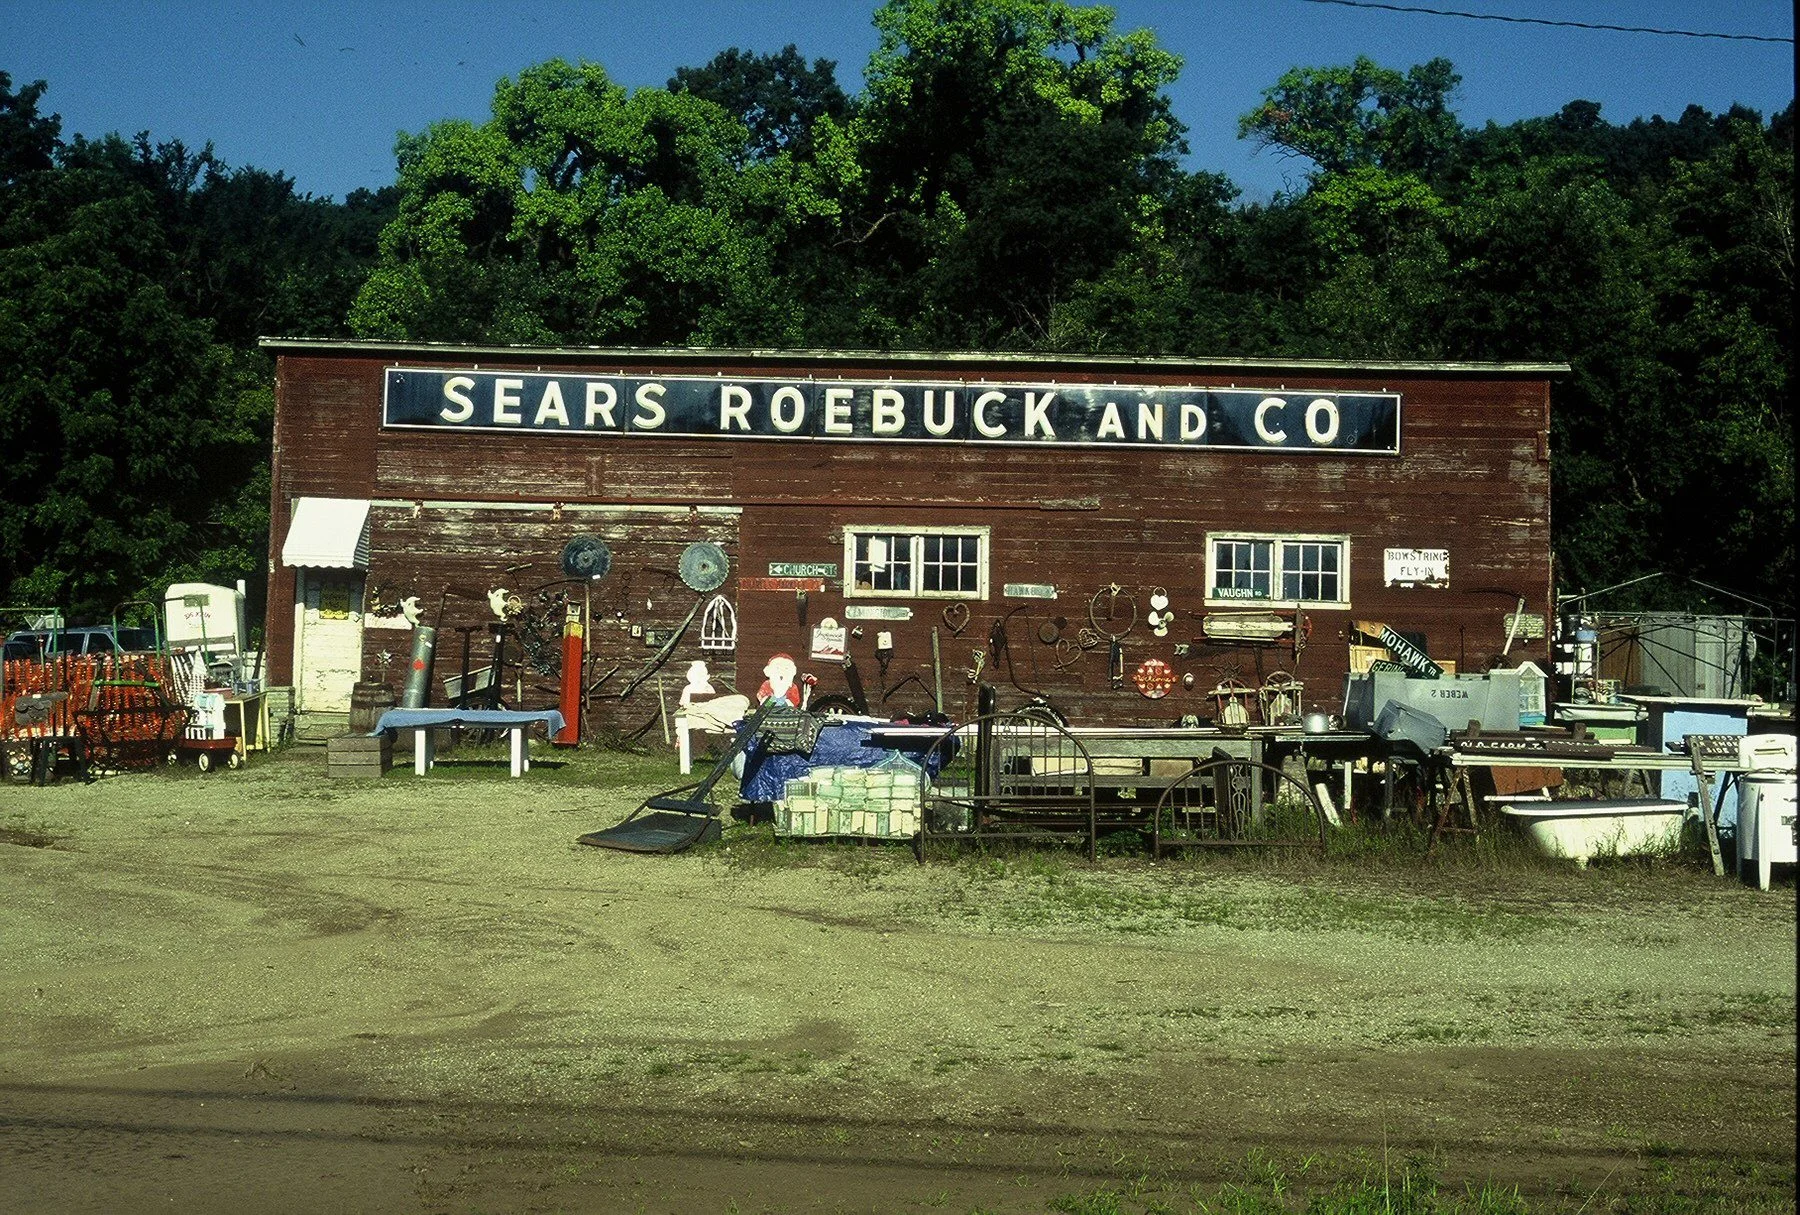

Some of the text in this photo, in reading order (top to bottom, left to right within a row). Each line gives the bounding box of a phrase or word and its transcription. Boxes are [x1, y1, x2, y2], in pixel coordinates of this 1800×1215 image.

[440, 377, 1340, 444] SEARS ROEBUCK AND CO
[784, 565, 818, 576] CHURCH
[1400, 566, 1433, 576] FLY-IN
[1217, 588, 1253, 598] VAUGHN
[1380, 627, 1437, 676] MOHAWK TR
[1431, 690, 1468, 698] WEBER 2
